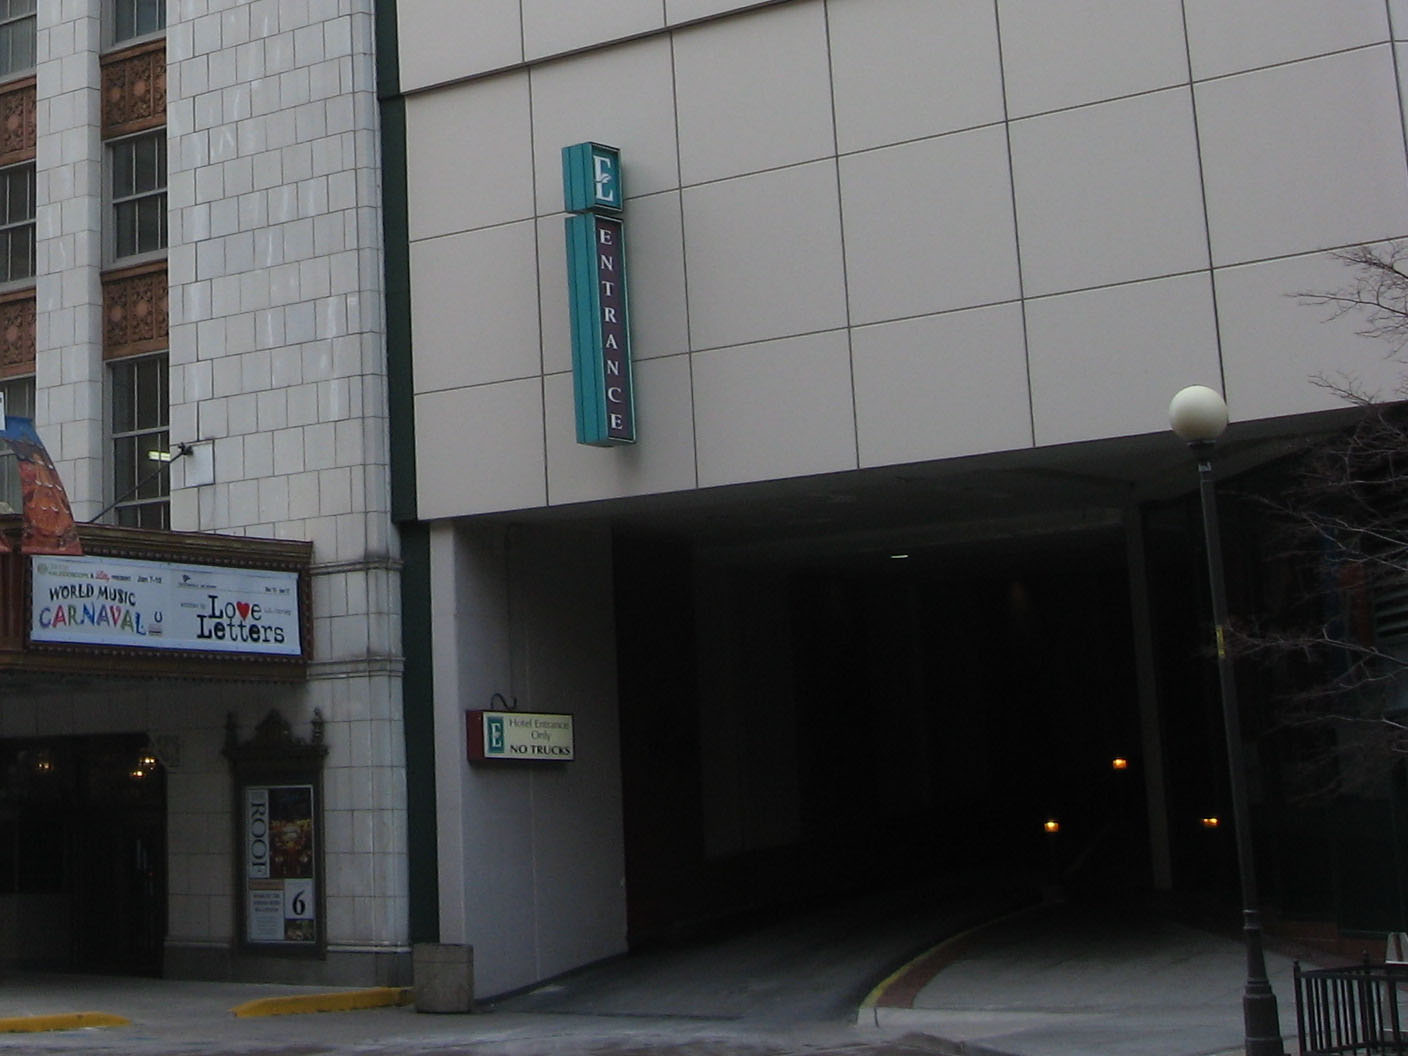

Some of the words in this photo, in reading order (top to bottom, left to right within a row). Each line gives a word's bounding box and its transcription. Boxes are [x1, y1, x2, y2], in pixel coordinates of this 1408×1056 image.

[599, 228, 624, 431] ENTRANCE
[49, 583, 95, 602] WORLD
[97, 585, 137, 607] MUSIC
[39, 602, 147, 636] CARNAVAL
[196, 614, 285, 644] Letters
[509, 745, 528, 755] NO
[530, 745, 571, 756] TRUCKS
[292, 889, 306, 916] 6
